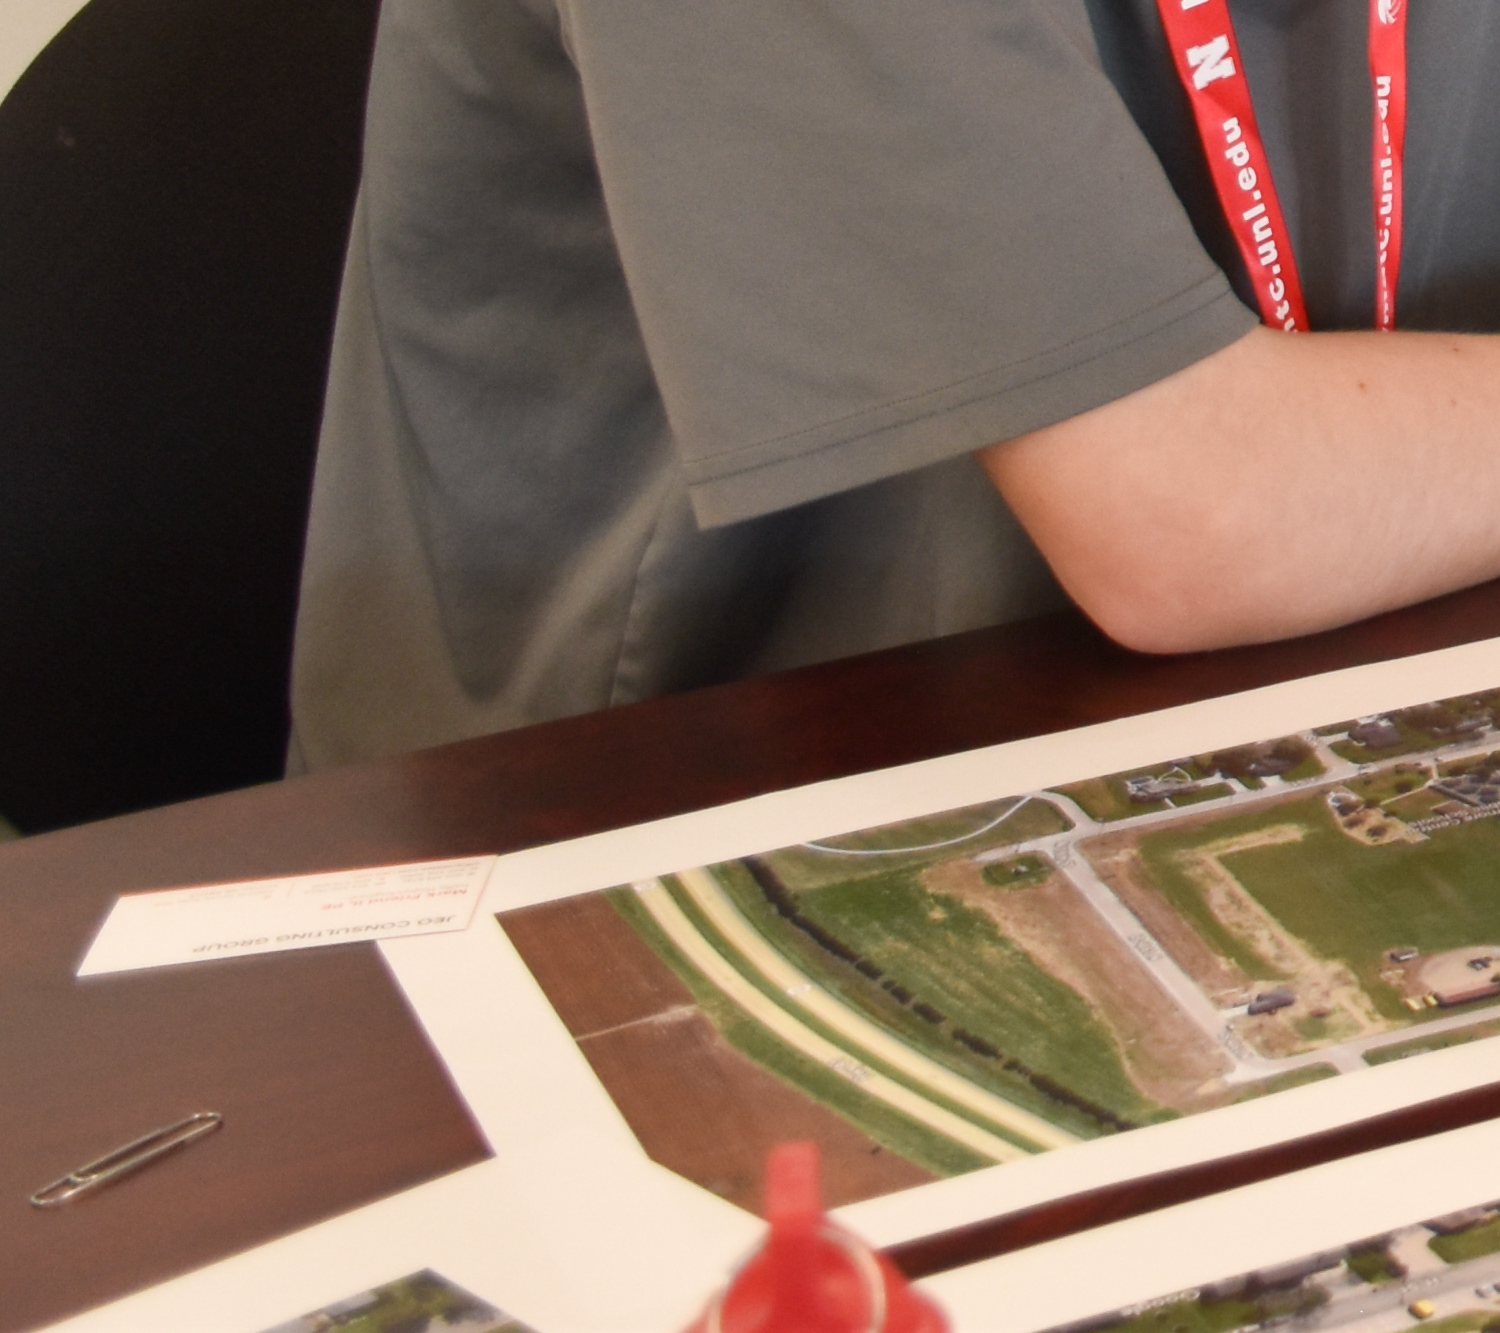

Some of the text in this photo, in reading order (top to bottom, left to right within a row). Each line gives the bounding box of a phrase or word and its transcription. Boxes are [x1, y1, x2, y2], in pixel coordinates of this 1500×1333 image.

[1187, 34, 1236, 90] N
[190, 914, 456, 953] JEO CONSULTING GROUP
